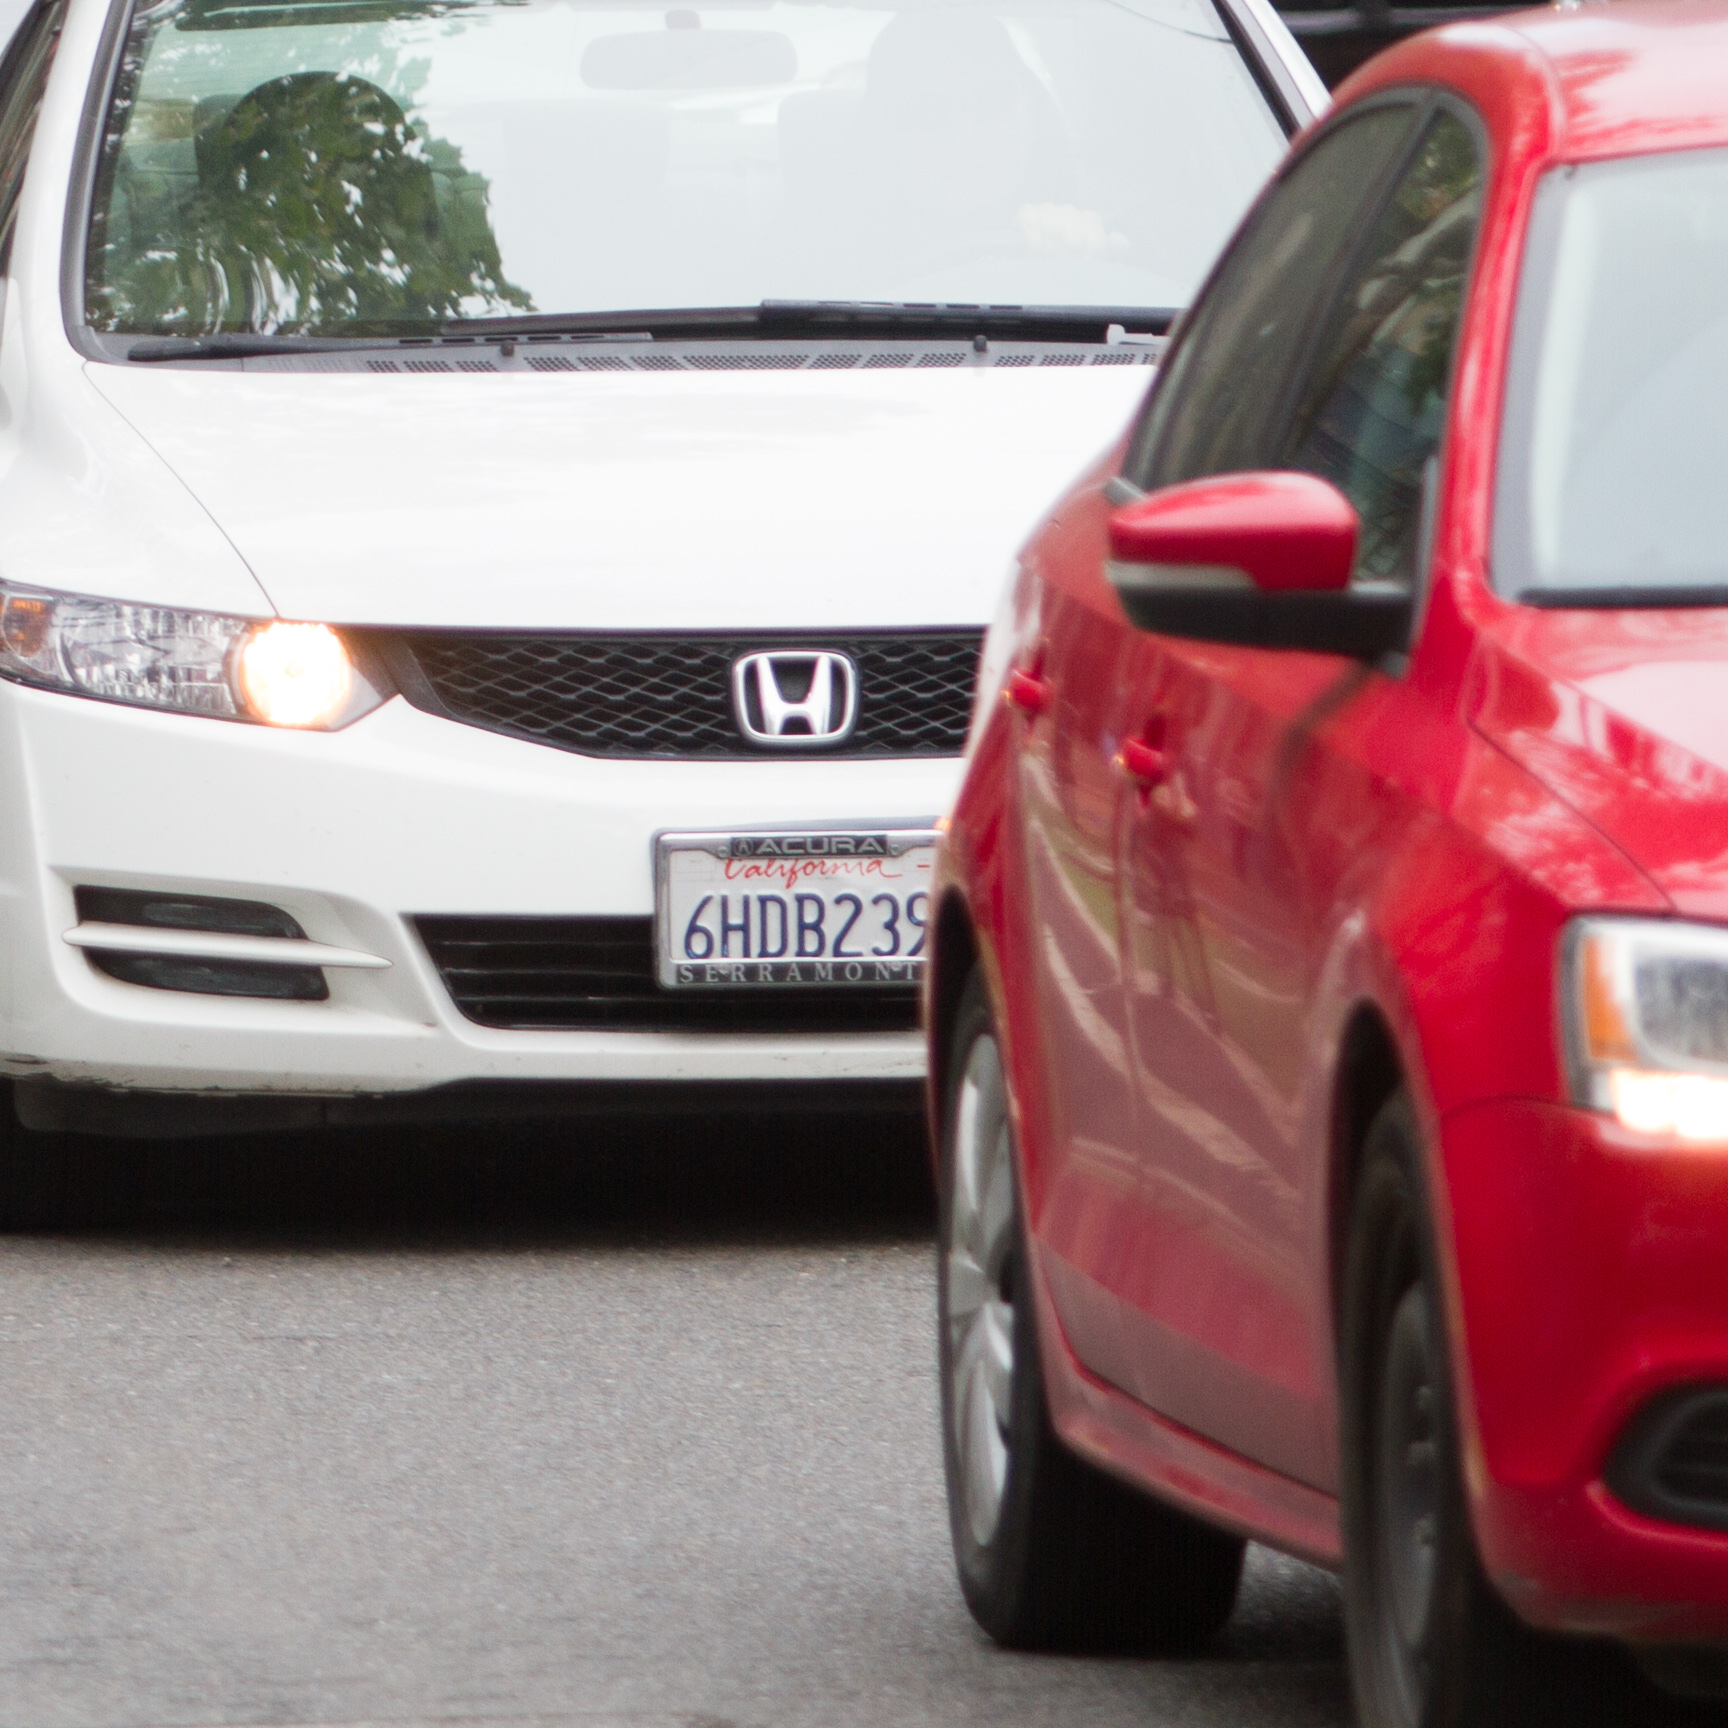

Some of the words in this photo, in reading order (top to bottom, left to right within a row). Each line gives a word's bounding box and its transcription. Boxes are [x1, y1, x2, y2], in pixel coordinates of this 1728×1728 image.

[756, 837, 884, 855] ACURA
[724, 858, 902, 889] California
[684, 891, 928, 959] 6HDB239
[679, 963, 919, 983] SERRAMONT
